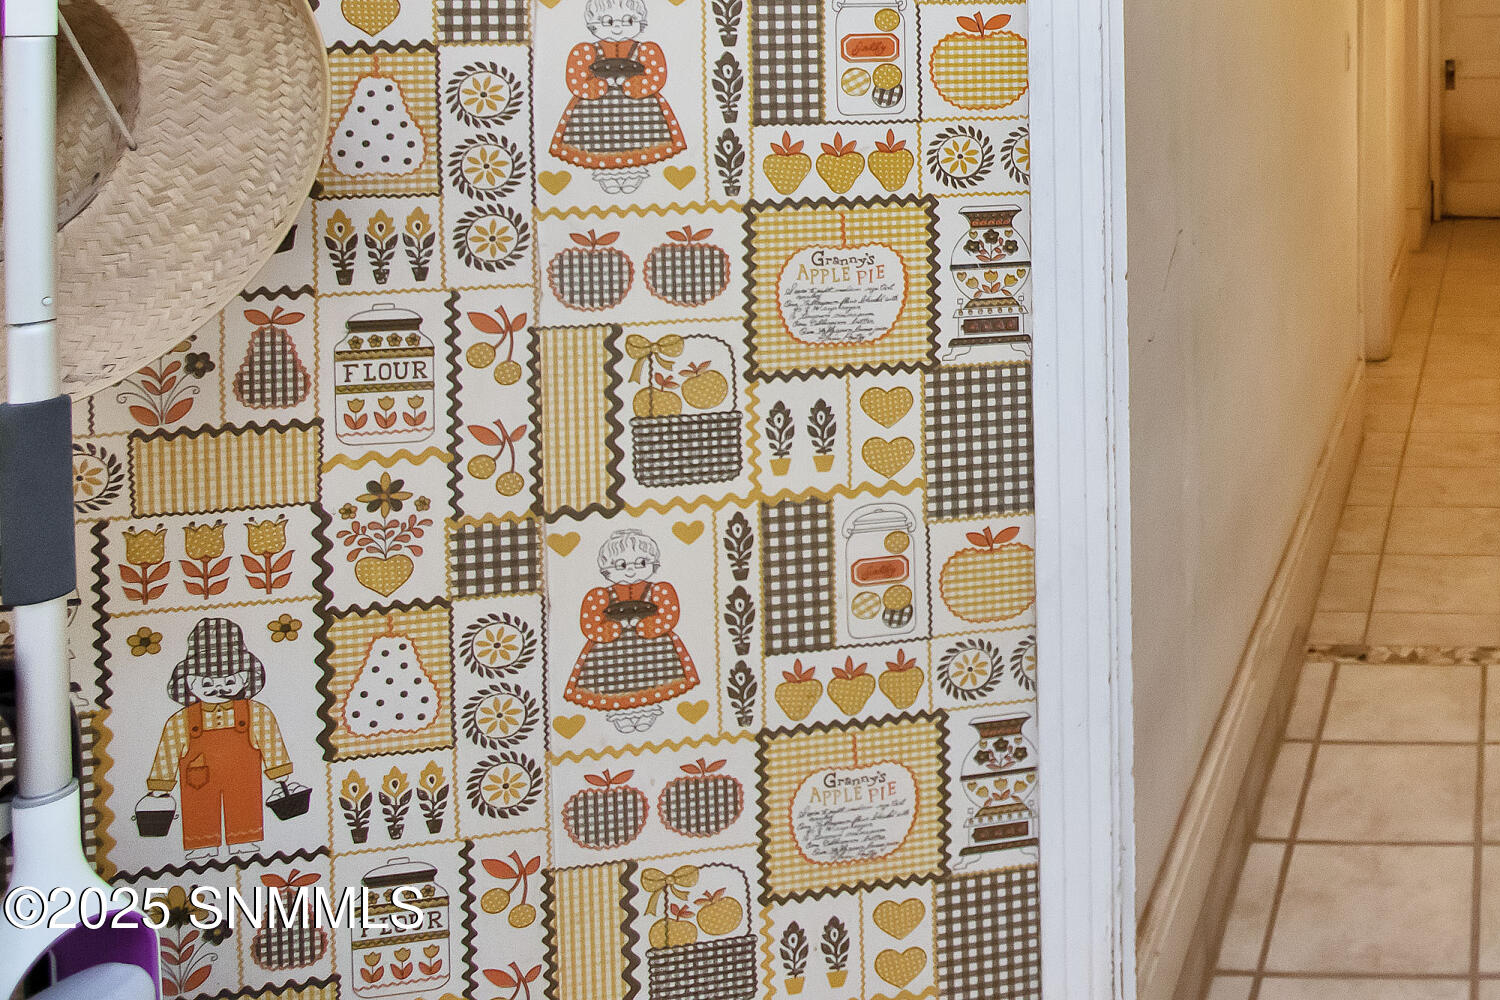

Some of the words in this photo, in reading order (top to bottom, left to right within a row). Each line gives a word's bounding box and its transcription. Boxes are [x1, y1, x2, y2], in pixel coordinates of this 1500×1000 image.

[811, 250, 875, 268] Granny's
[796, 263, 851, 285] APPLE
[856, 264, 885, 285] PIE
[342, 360, 428, 383] FLOUR
[823, 770, 887, 788] Granny's
[809, 786, 862, 806] APPLE
[868, 781, 897, 803] PIE
